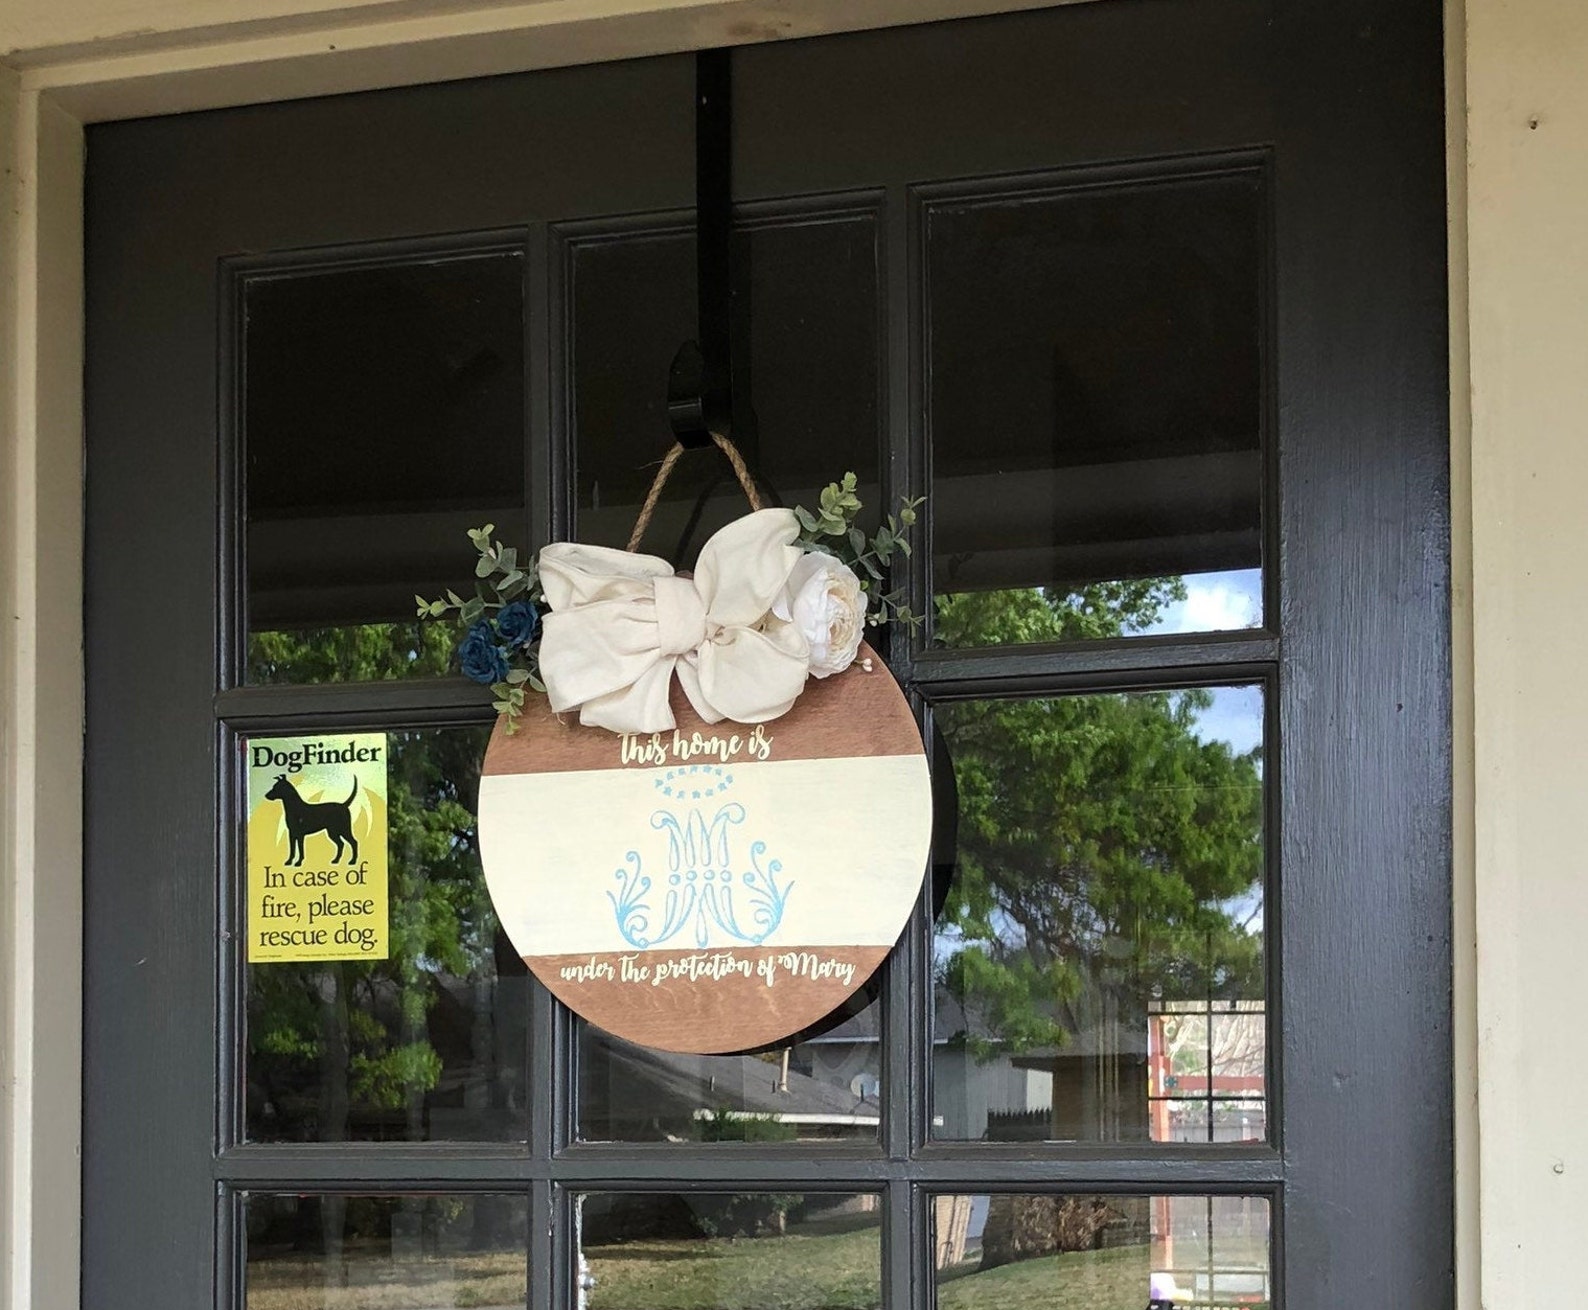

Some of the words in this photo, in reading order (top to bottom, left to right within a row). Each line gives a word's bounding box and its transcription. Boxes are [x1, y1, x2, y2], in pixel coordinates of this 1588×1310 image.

[251, 741, 382, 773] DogFinder
[673, 728, 744, 763] home
[748, 724, 774, 761] is
[263, 866, 286, 889] In
[292, 869, 339, 887] case
[345, 861, 369, 885] of
[261, 895, 302, 924] fire,
[308, 893, 375, 924] please
[259, 928, 328, 948] rescue
[334, 921, 379, 951] dog.
[560, 956, 616, 984] under
[618, 953, 651, 983] the
[651, 951, 754, 987] protection
[756, 955, 776, 988] of
[777, 951, 857, 987] Mary
